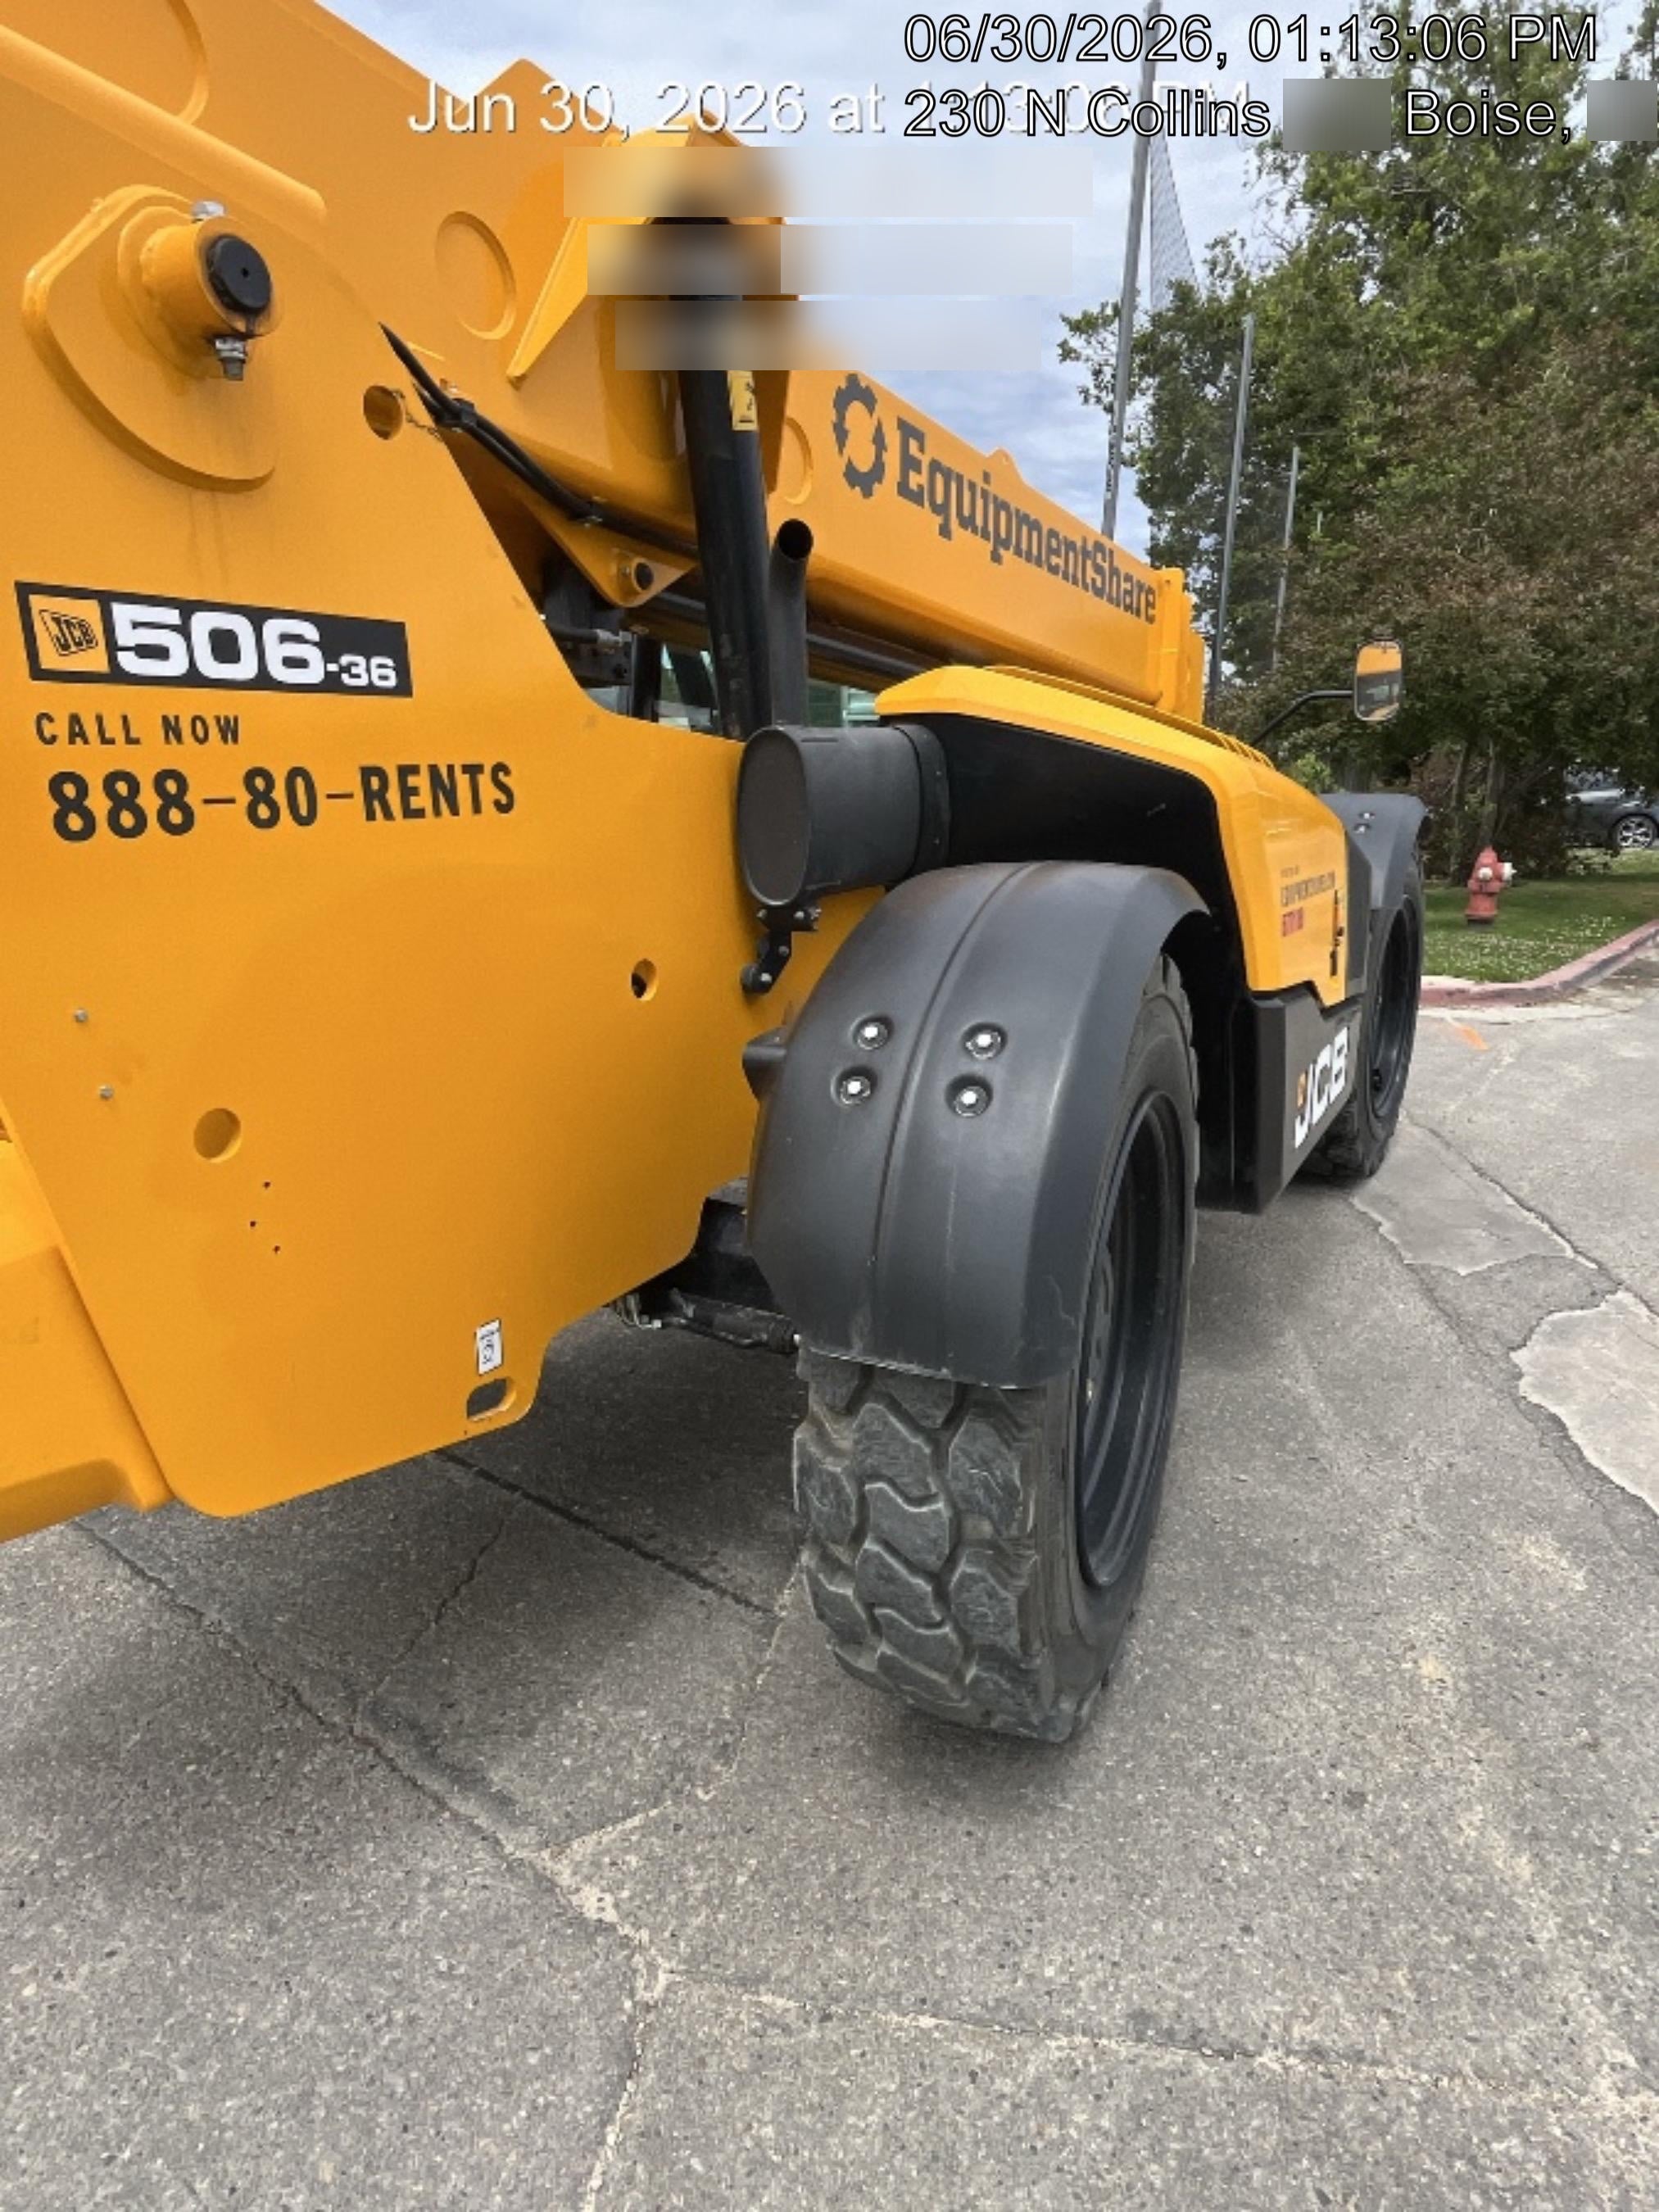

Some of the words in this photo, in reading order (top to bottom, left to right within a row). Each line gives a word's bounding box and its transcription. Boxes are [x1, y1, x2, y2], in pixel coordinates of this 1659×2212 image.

[895, 415, 1157, 626] EquipmentShare
[45, 610, 97, 655] JCB
[109, 601, 399, 689] 506-36
[34, 711, 142, 746] CALL
[161, 714, 241, 746] NOW
[47, 760, 516, 843] 888-80-RENTS
[1294, 1026, 1350, 1149] JCB
